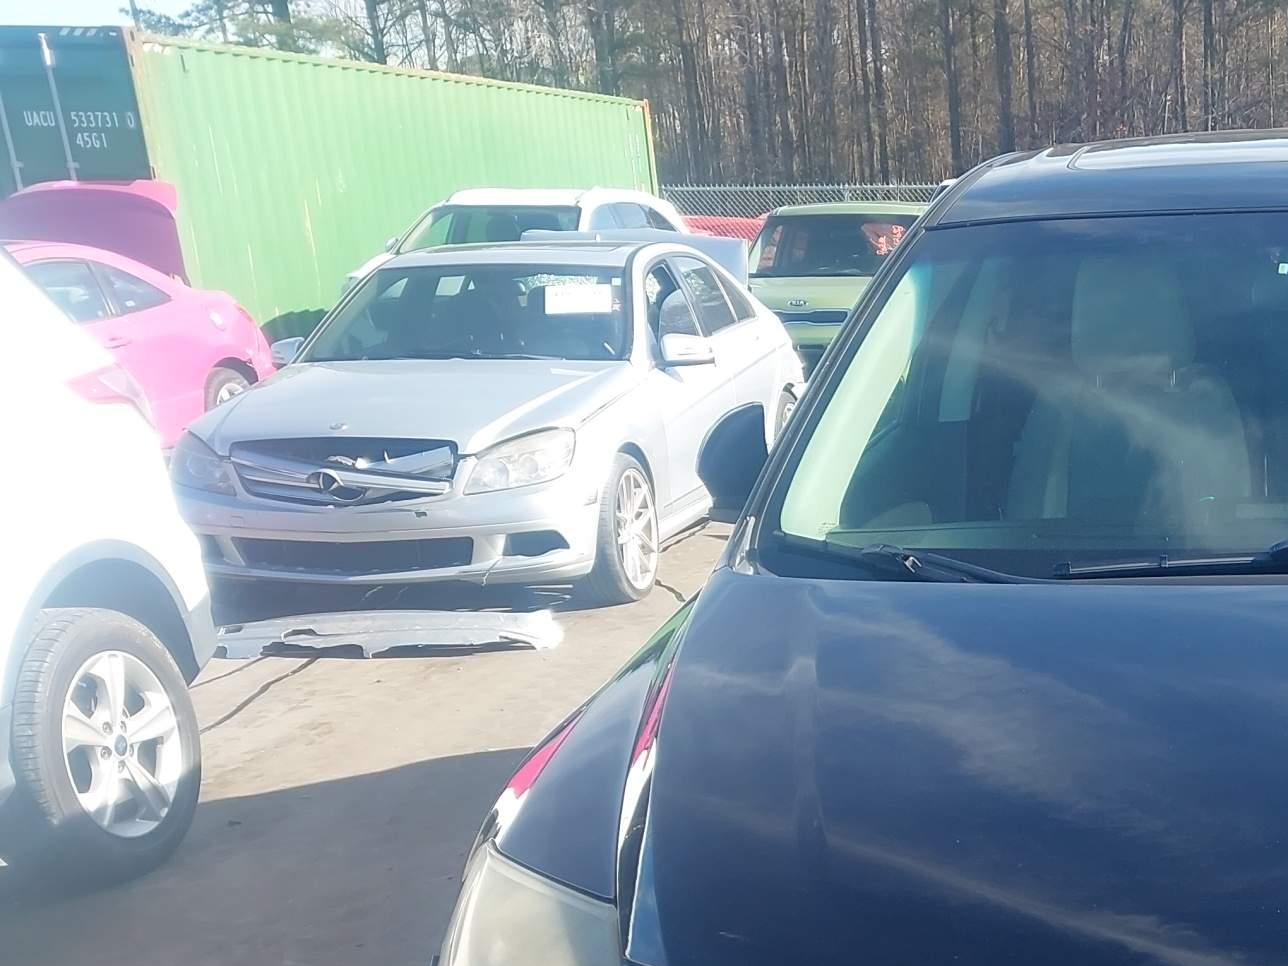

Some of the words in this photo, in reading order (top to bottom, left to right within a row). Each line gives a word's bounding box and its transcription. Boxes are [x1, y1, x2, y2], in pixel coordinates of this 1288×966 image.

[23, 110, 56, 127] UACU
[70, 111, 119, 128] 533731
[76, 132, 107, 149] 45G1
